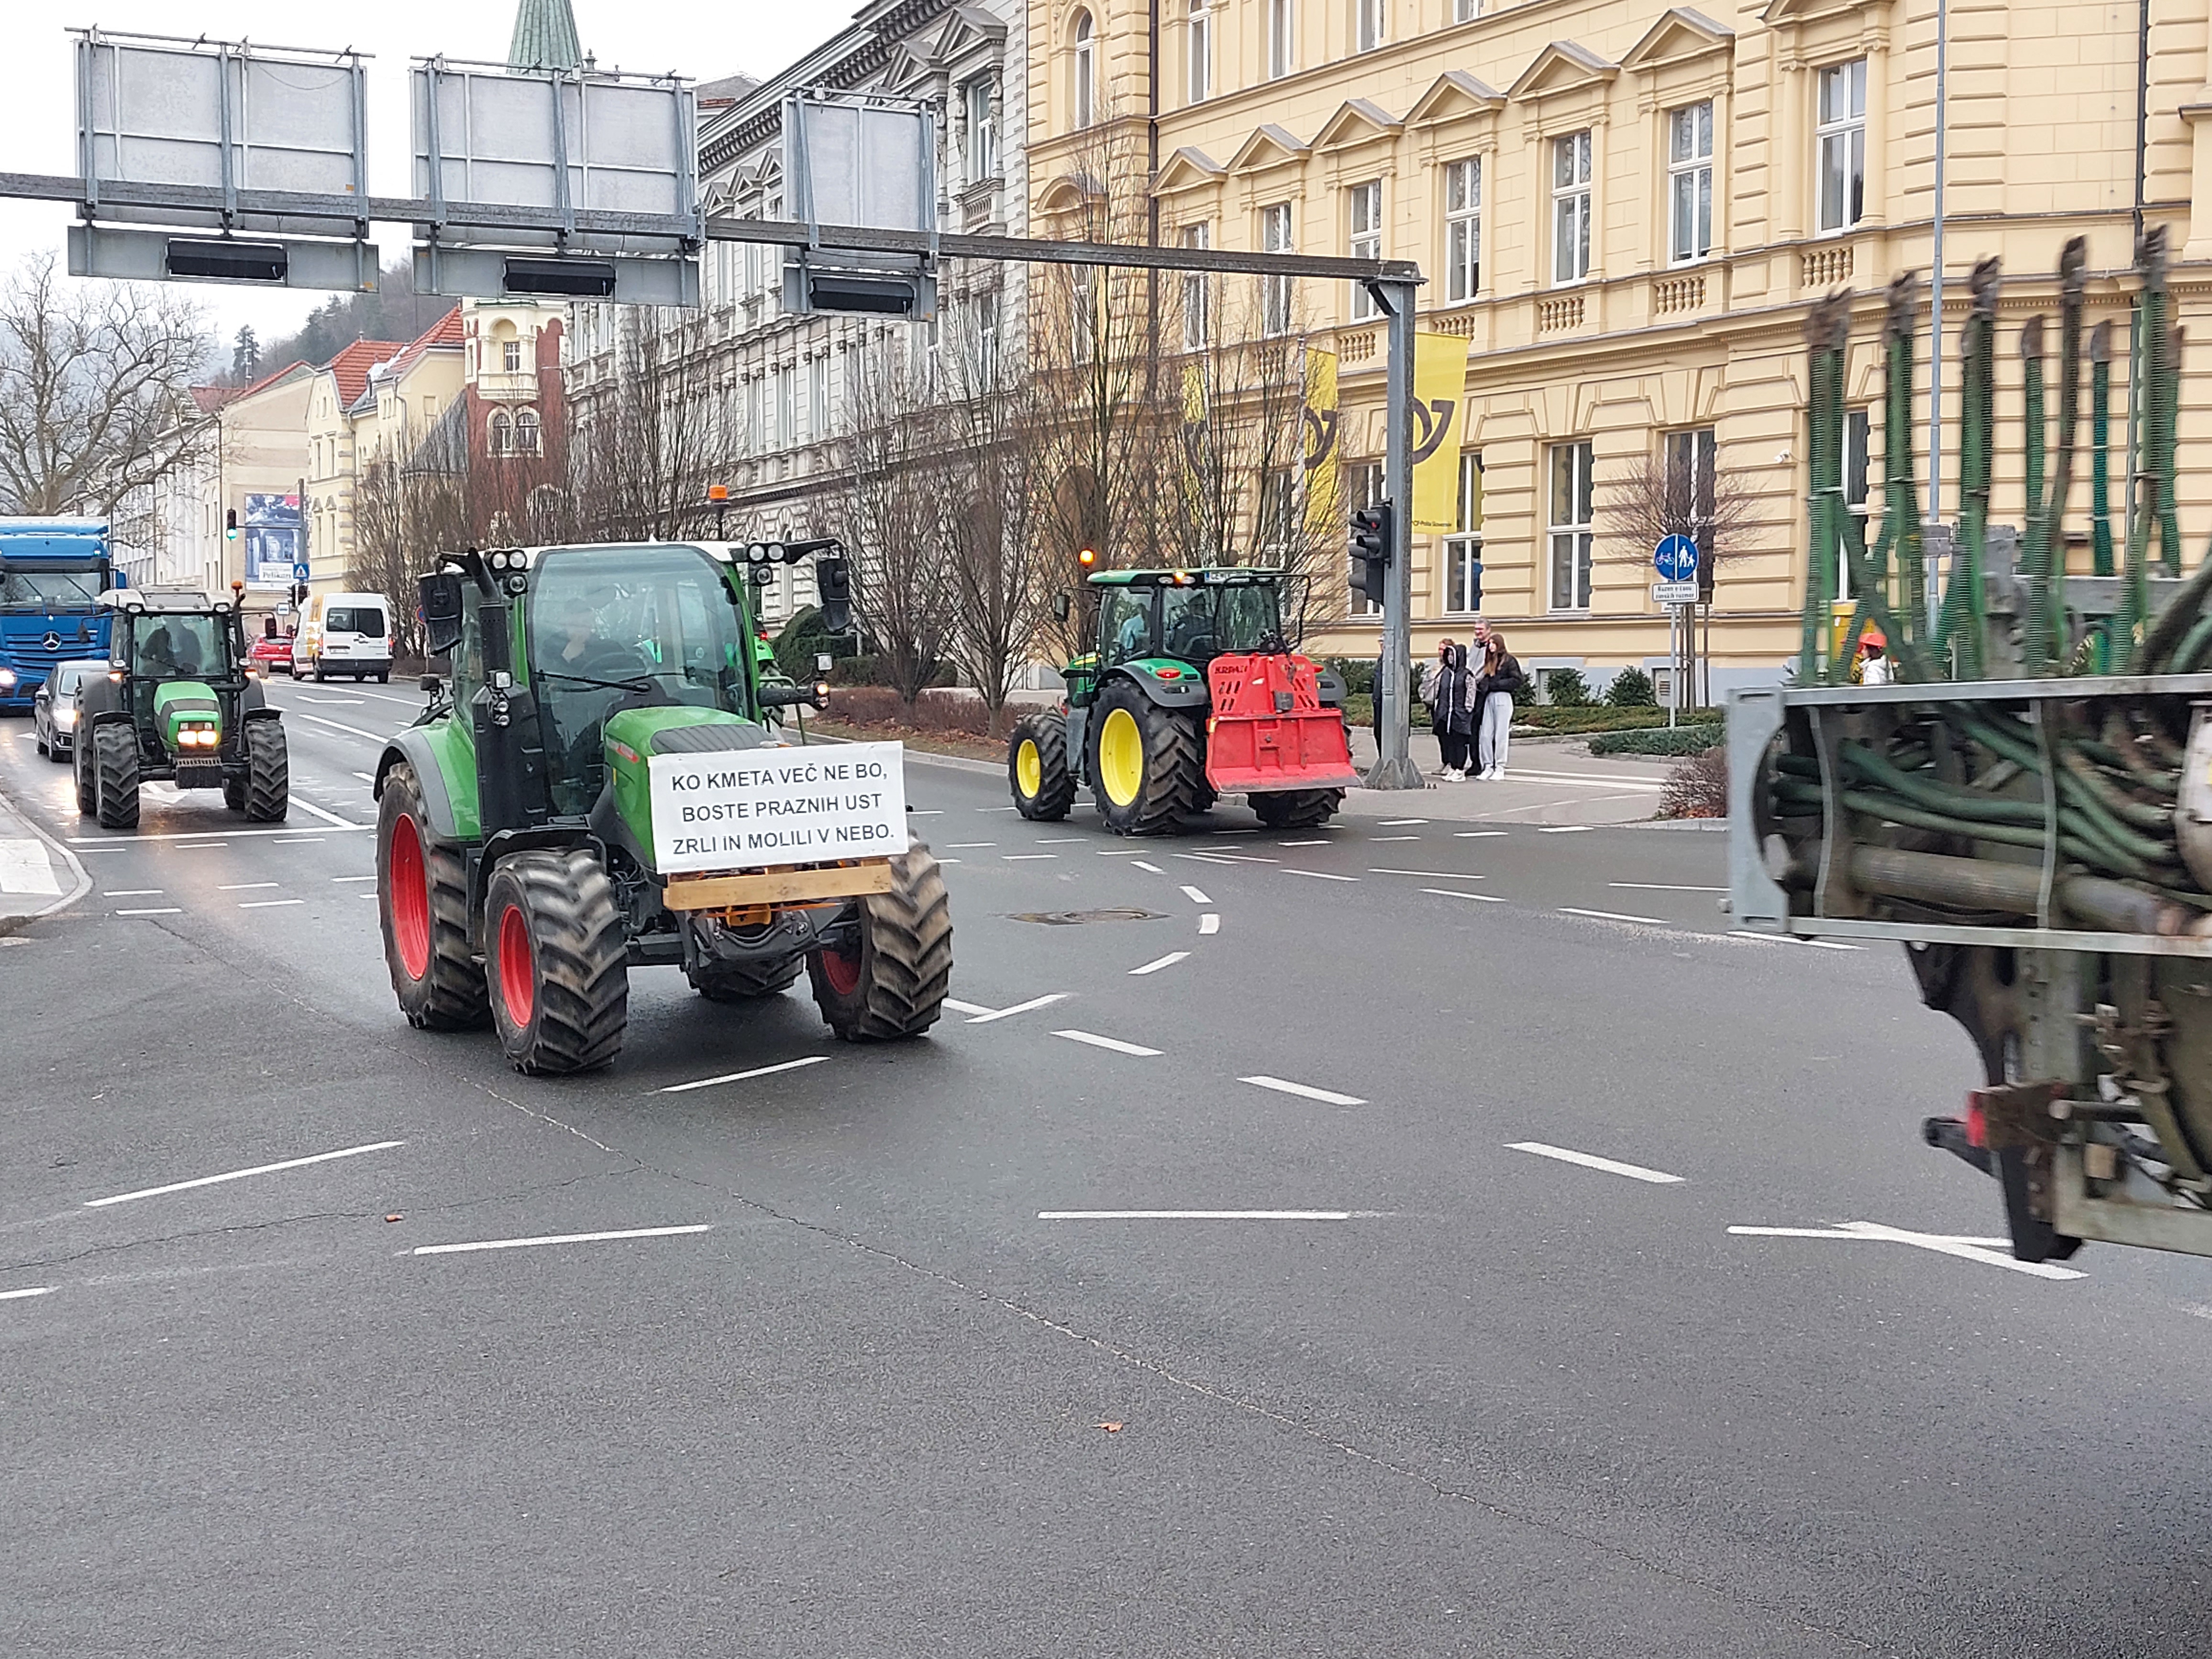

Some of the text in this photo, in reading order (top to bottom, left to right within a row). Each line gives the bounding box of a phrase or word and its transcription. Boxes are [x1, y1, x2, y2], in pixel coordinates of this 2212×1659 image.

[672, 763, 886, 791] KO KMETA VEČ NE BO,
[683, 794, 881, 822] BOSTE PRAZNIH UST
[673, 824, 894, 854] ZRLI IN MOLILI V NEBO.
